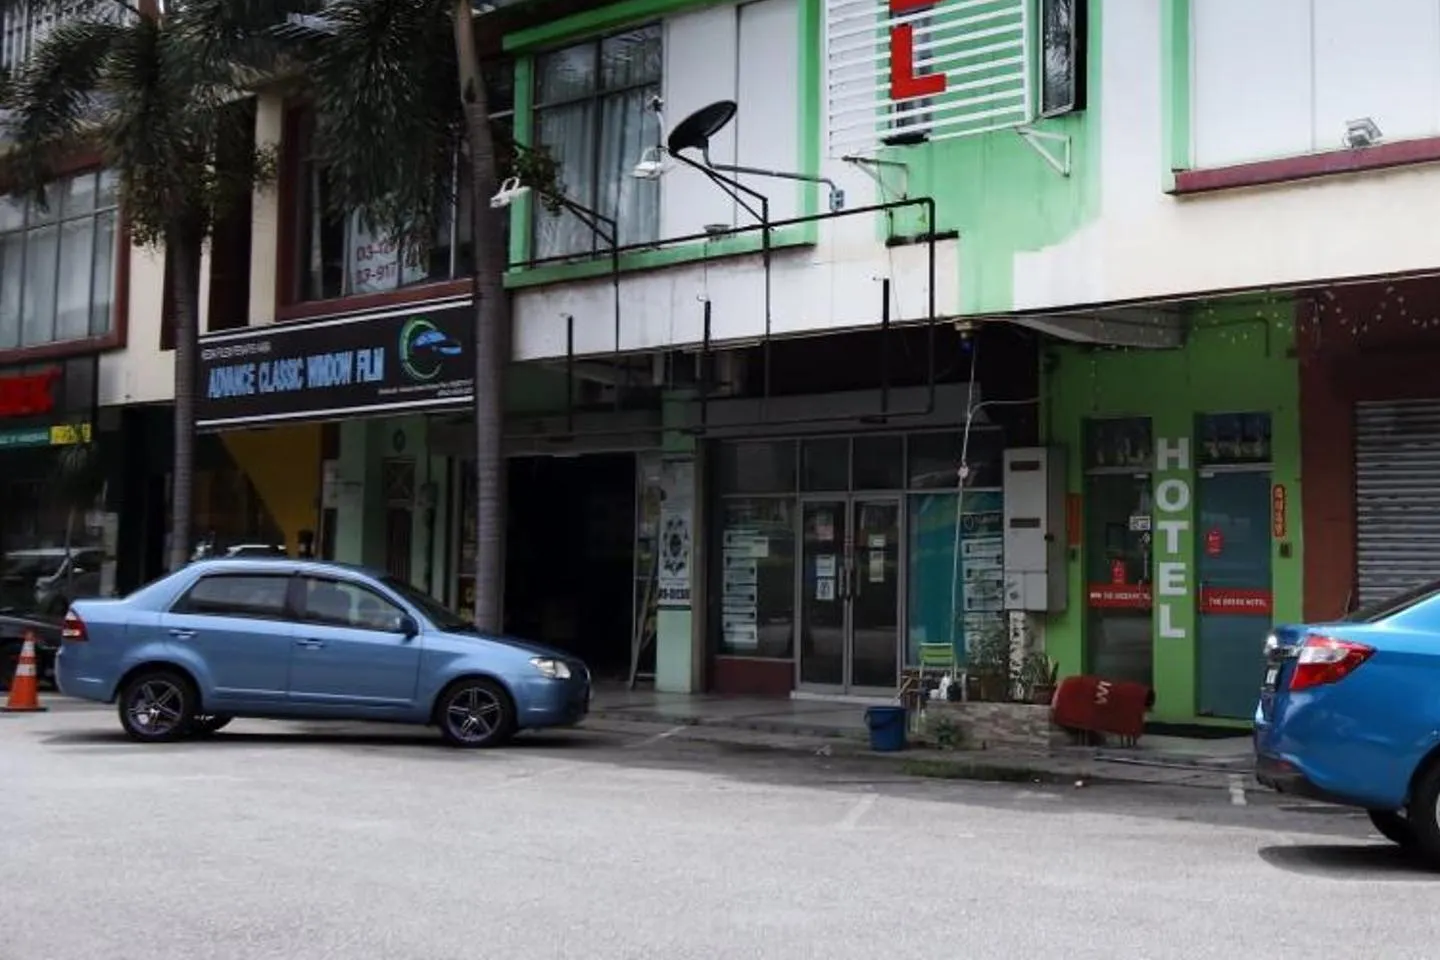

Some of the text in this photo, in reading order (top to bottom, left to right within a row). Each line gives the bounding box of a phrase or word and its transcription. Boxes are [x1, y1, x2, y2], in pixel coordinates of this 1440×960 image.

[259, 358, 304, 393] CLASSIC
[307, 351, 353, 388] WINDOW
[357, 347, 384, 383] FILM
[1156, 437, 1190, 638] HOTEL
